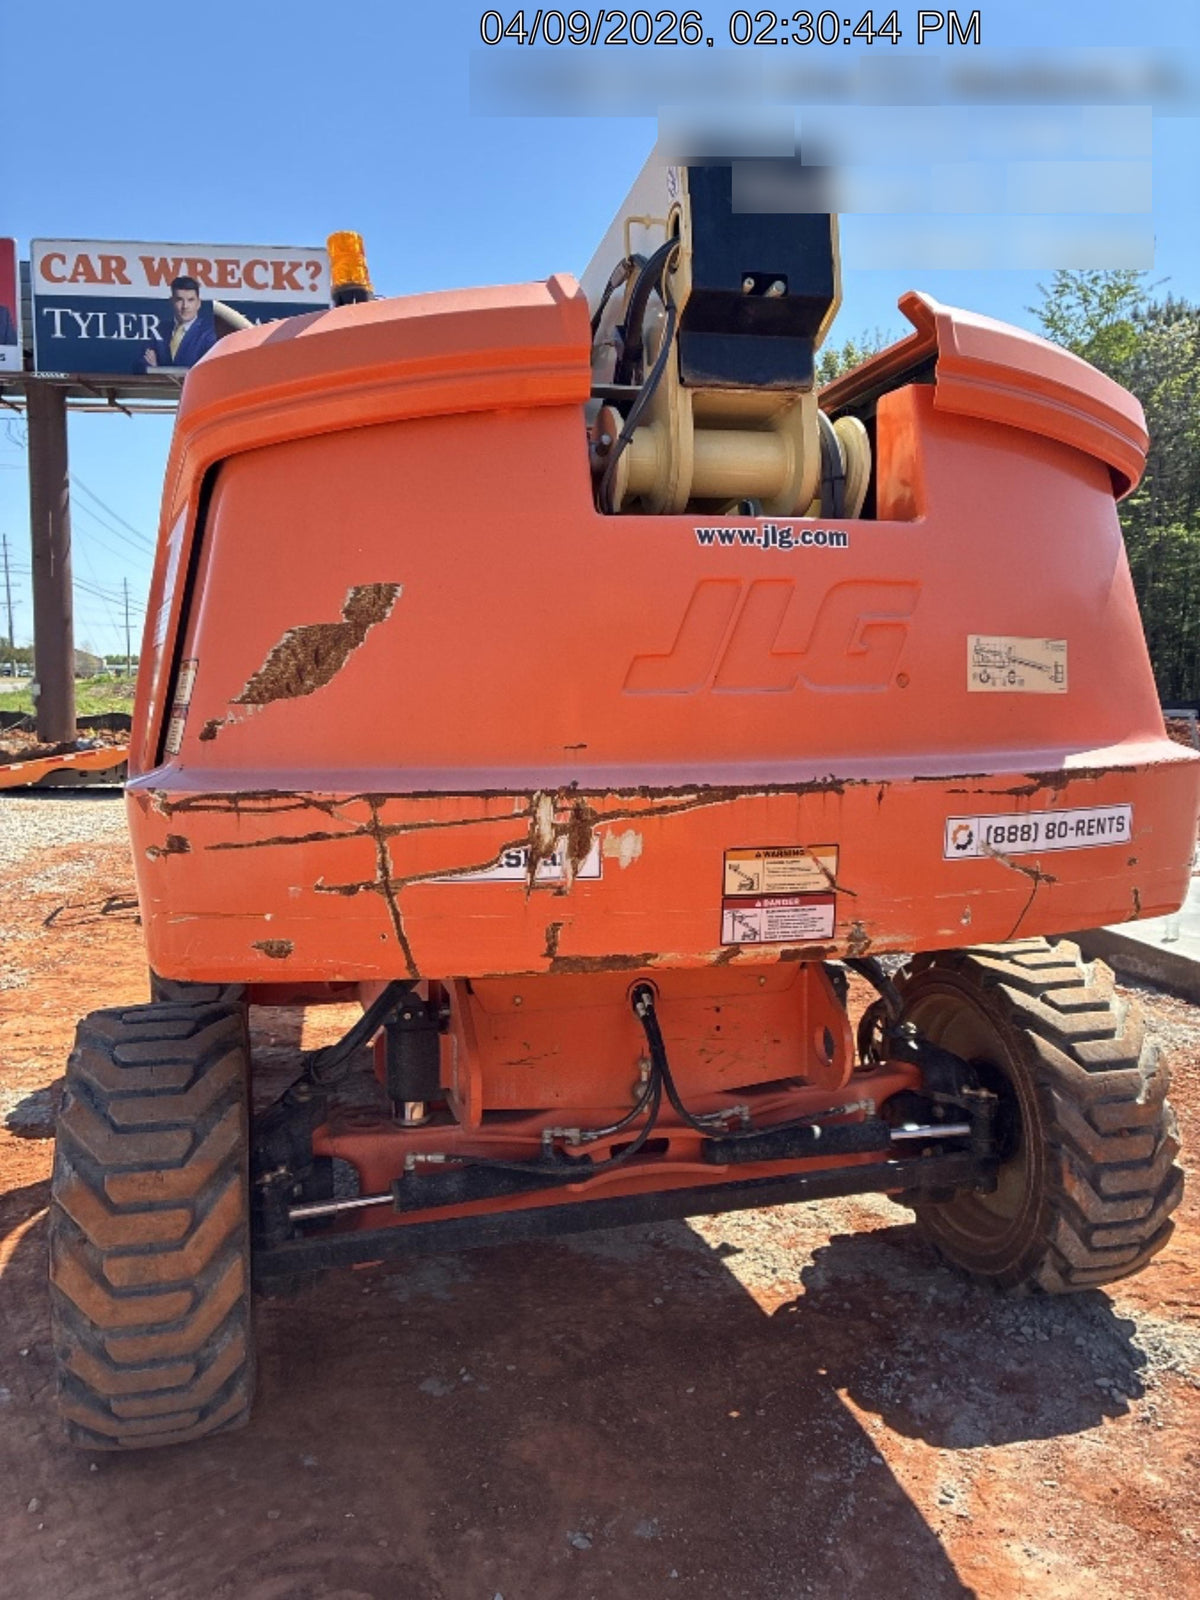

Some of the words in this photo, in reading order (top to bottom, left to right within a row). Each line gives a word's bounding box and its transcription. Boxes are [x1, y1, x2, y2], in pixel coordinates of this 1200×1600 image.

[40, 252, 132, 286] CAR
[139, 255, 323, 292] WRECK?
[43, 307, 164, 341] TYLER
[695, 524, 848, 549] www.jlg.com
[622, 577, 922, 694] JLG
[986, 823, 1039, 846] (888)
[1045, 815, 1125, 840] 80-RENTS
[763, 849, 805, 859] WARNING
[763, 898, 800, 907] DANGER
